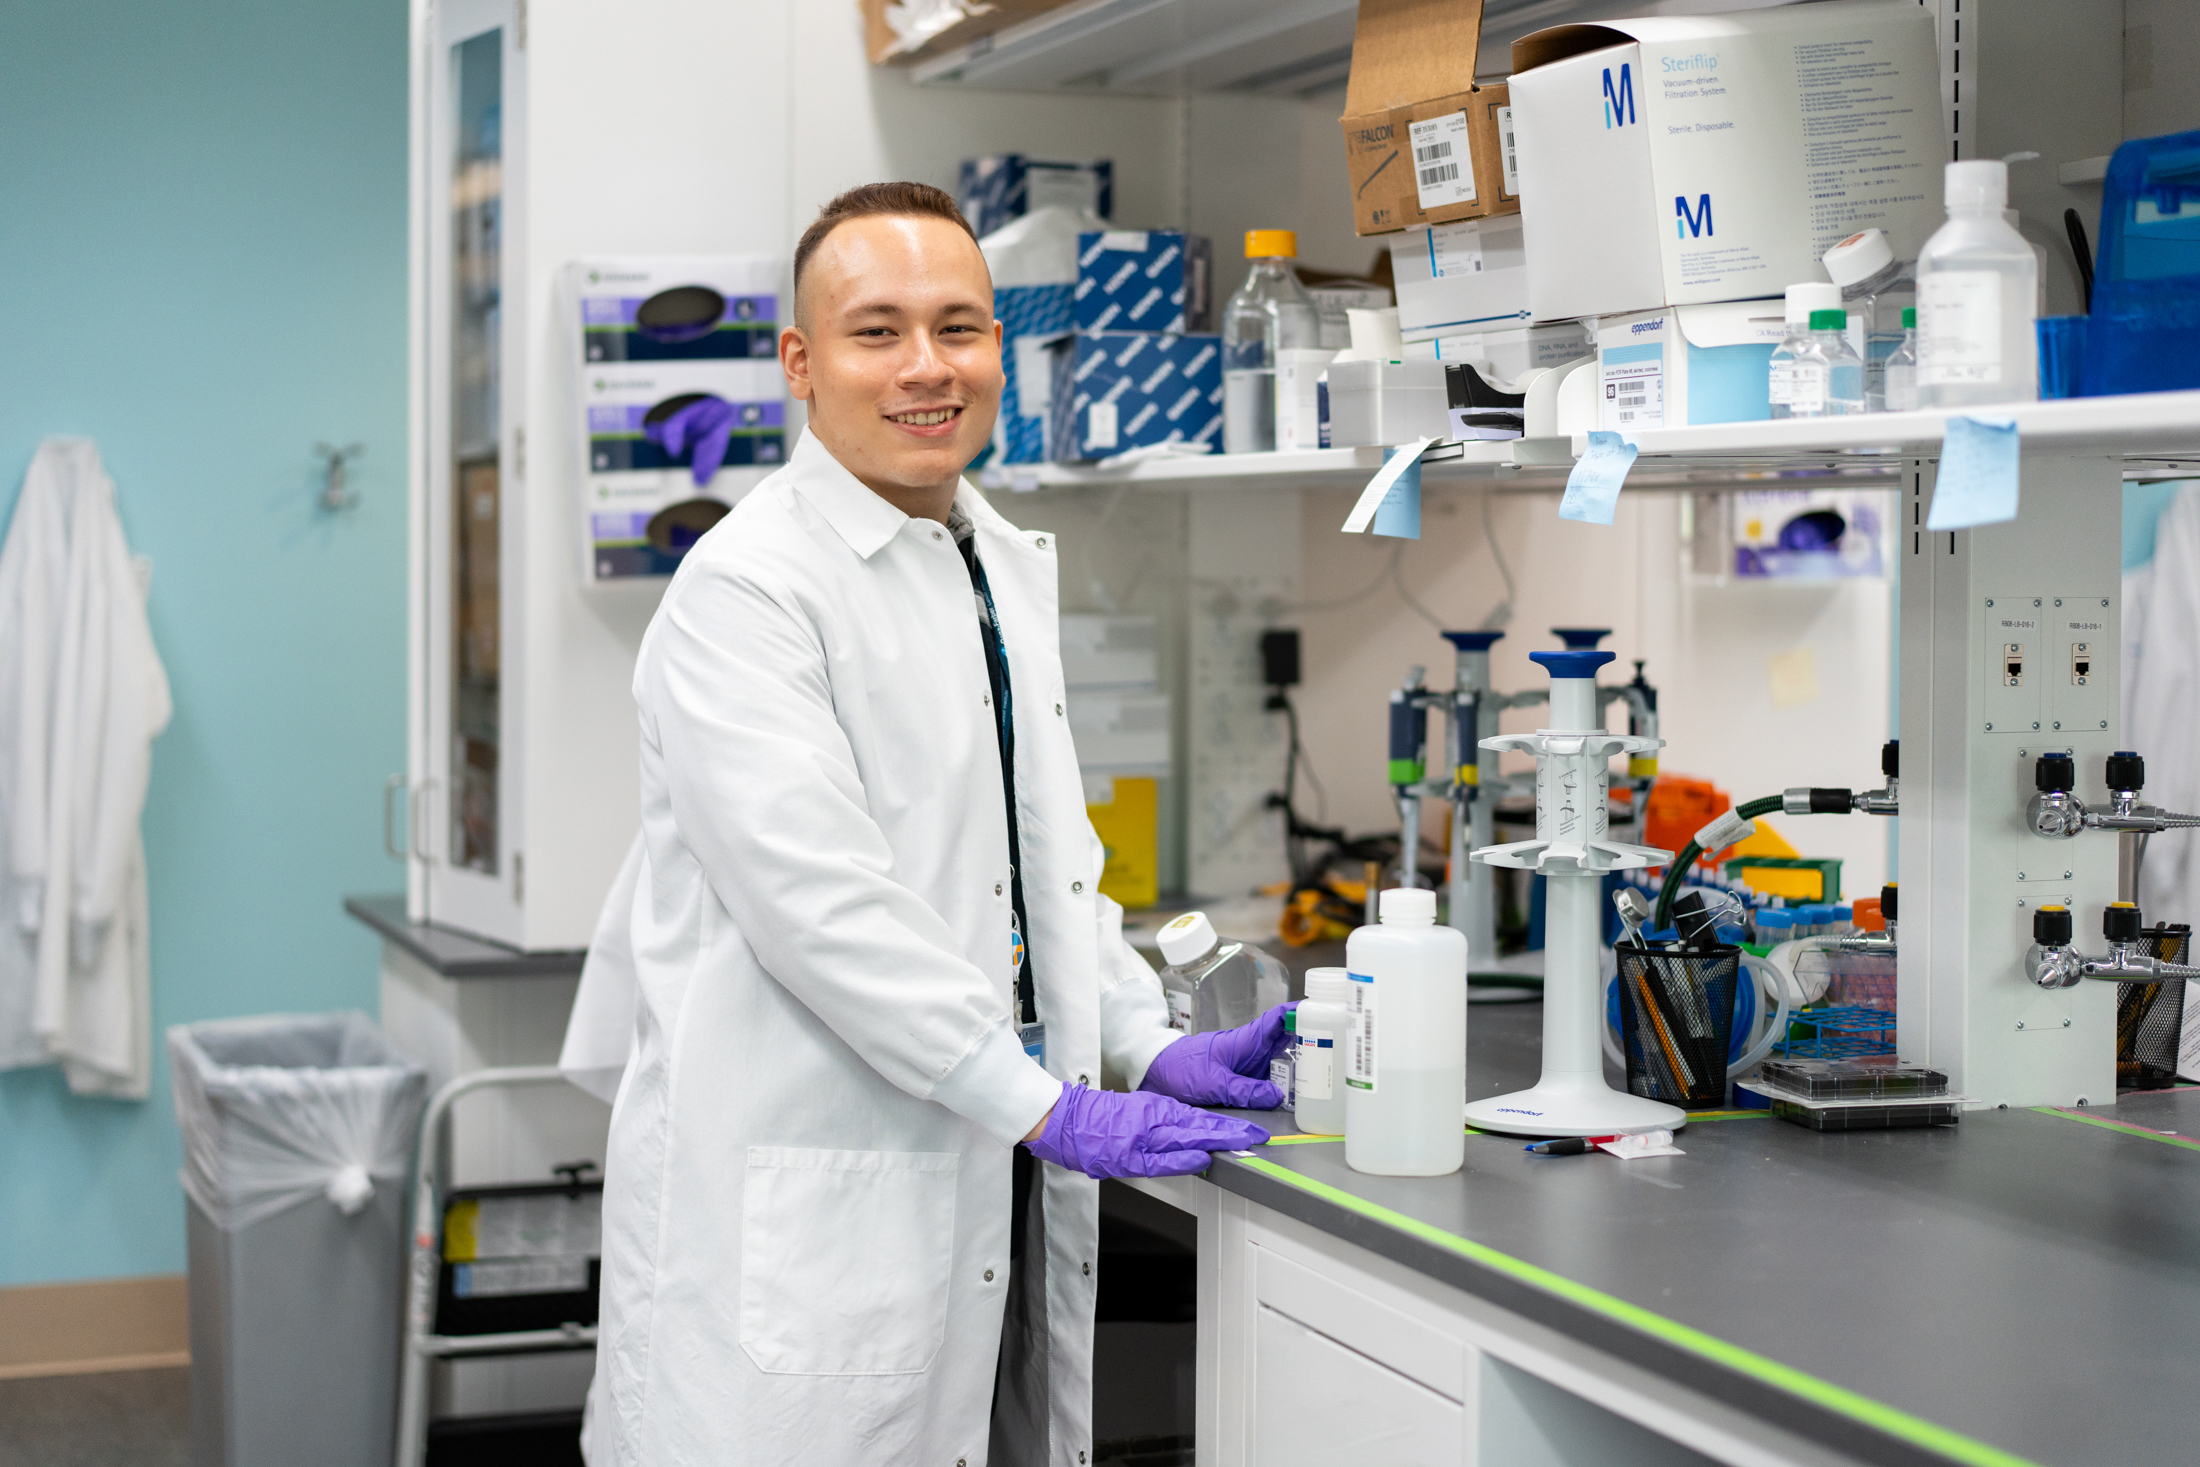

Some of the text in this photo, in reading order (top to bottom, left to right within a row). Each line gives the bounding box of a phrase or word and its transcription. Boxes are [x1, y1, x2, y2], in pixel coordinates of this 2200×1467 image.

[1661, 53, 1718, 73] Steriflip
[1662, 76, 1718, 88] Vacuum-driven
[1664, 87, 1726, 99] Filtration System
[1360, 123, 1394, 144] FALCON
[1668, 121, 1736, 134] Sterile. Disposable.
[1631, 318, 1663, 336] eppendorf
[1539, 350, 1586, 362] protein purification
[1608, 386, 1615, 397] 96
[1496, 1108, 1544, 1116] eppendorf
